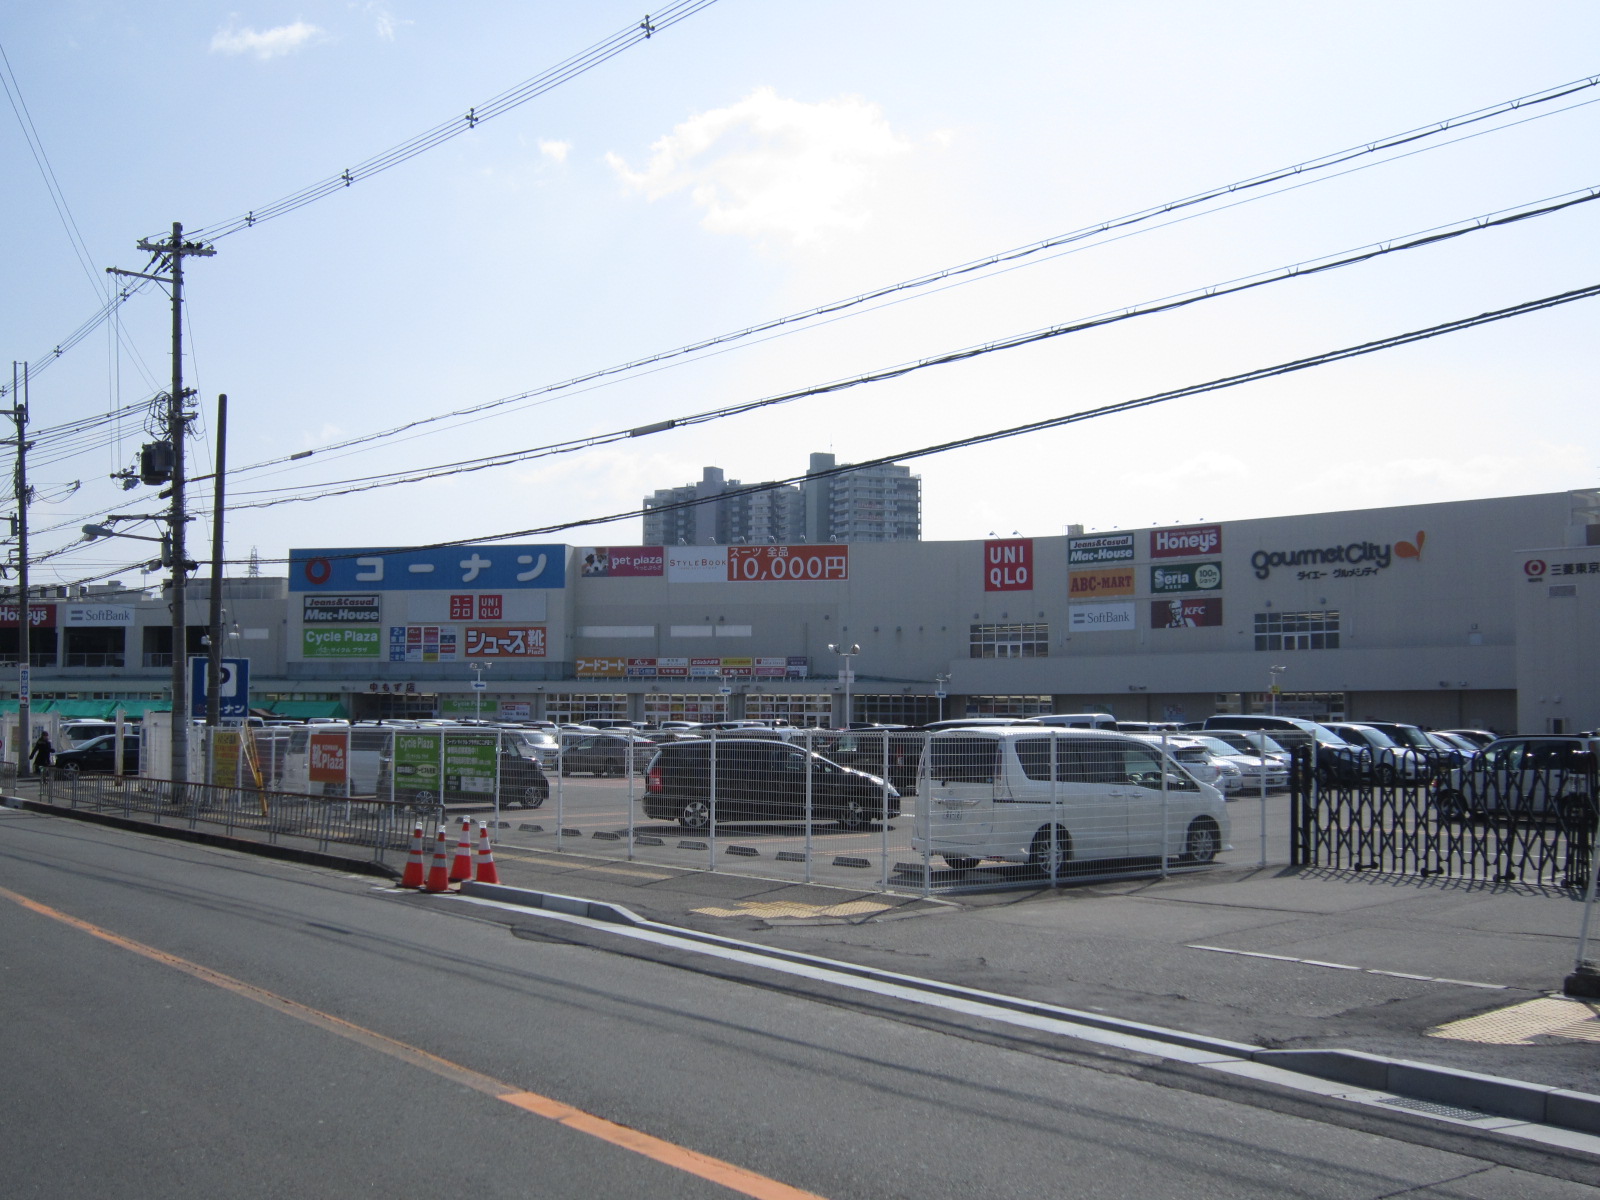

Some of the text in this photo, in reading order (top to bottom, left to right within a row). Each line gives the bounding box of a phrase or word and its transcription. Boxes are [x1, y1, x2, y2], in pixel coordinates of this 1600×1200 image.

[1073, 537, 1129, 549] Jeans&Casual
[1156, 531, 1218, 553] Honeys
[730, 546, 789, 558] スーツ 全品
[990, 545, 1024, 564] UNI
[1069, 547, 1133, 562] Mac-House
[355, 553, 547, 582] コーナン
[611, 556, 663, 570] pet plaza
[730, 556, 846, 580] 10,000円
[1550, 561, 1600, 576] 三菱東京
[989, 566, 1027, 588] QLO
[1154, 568, 1190, 588] Seria
[1297, 567, 1380, 581] ダイエー グルメシティ
[1070, 575, 1133, 593] ABC-MART
[309, 597, 375, 607] Jeans&Casual
[452, 597, 471, 608] ユニ
[481, 597, 499, 607] UNI
[0, 607, 47, 626] Hoeys
[85, 609, 131, 621] SoftBank
[304, 608, 379, 621] Mac-House
[452, 608, 471, 618] クロ
[481, 607, 500, 618] QLO
[1086, 611, 1130, 624] SoftBank
[1184, 606, 1206, 615] KFC
[305, 630, 342, 645] Cycle
[344, 630, 378, 642] Plaza
[467, 629, 526, 654] シューズ
[576, 659, 625, 671] フードコート
[399, 737, 417, 752] Cycle
[417, 737, 434, 749] Plaza
[322, 753, 345, 770] Plaza
